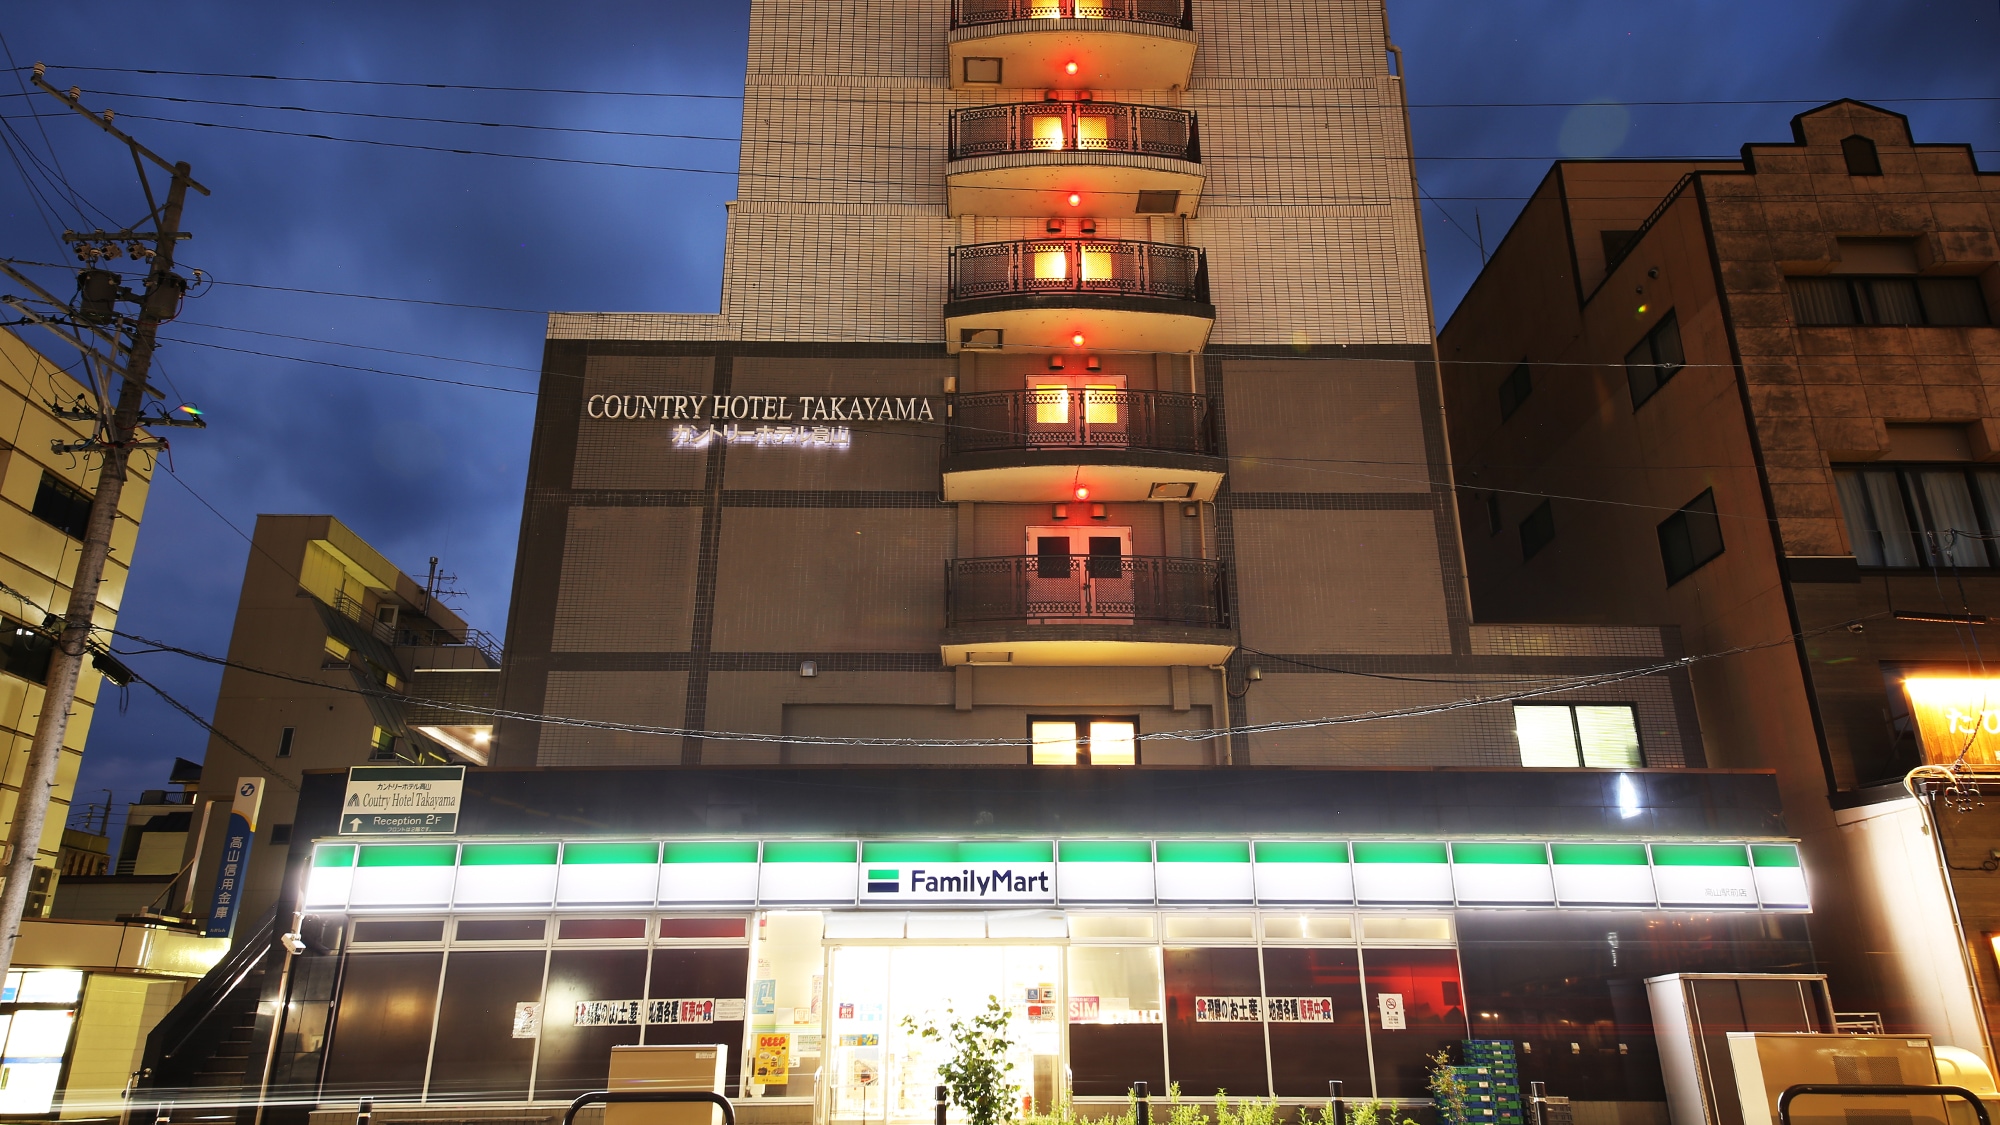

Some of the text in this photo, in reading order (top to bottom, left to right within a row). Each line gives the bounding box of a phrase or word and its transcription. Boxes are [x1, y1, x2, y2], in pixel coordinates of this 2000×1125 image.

[587, 394, 935, 421] COUNTRY HOTEL TAKAYAMA
[672, 424, 850, 443] カントリーホテル高山
[377, 783, 432, 791] カントリーホテル高山
[362, 792, 456, 810] Coutry Hotel Takayama
[373, 814, 442, 826] Reception 2F
[214, 836, 244, 919] 高山信用金庫
[911, 869, 1049, 896] FamilyMart
[1704, 887, 1748, 897] 高山駅前店
[1069, 1002, 1098, 1018] SIM
